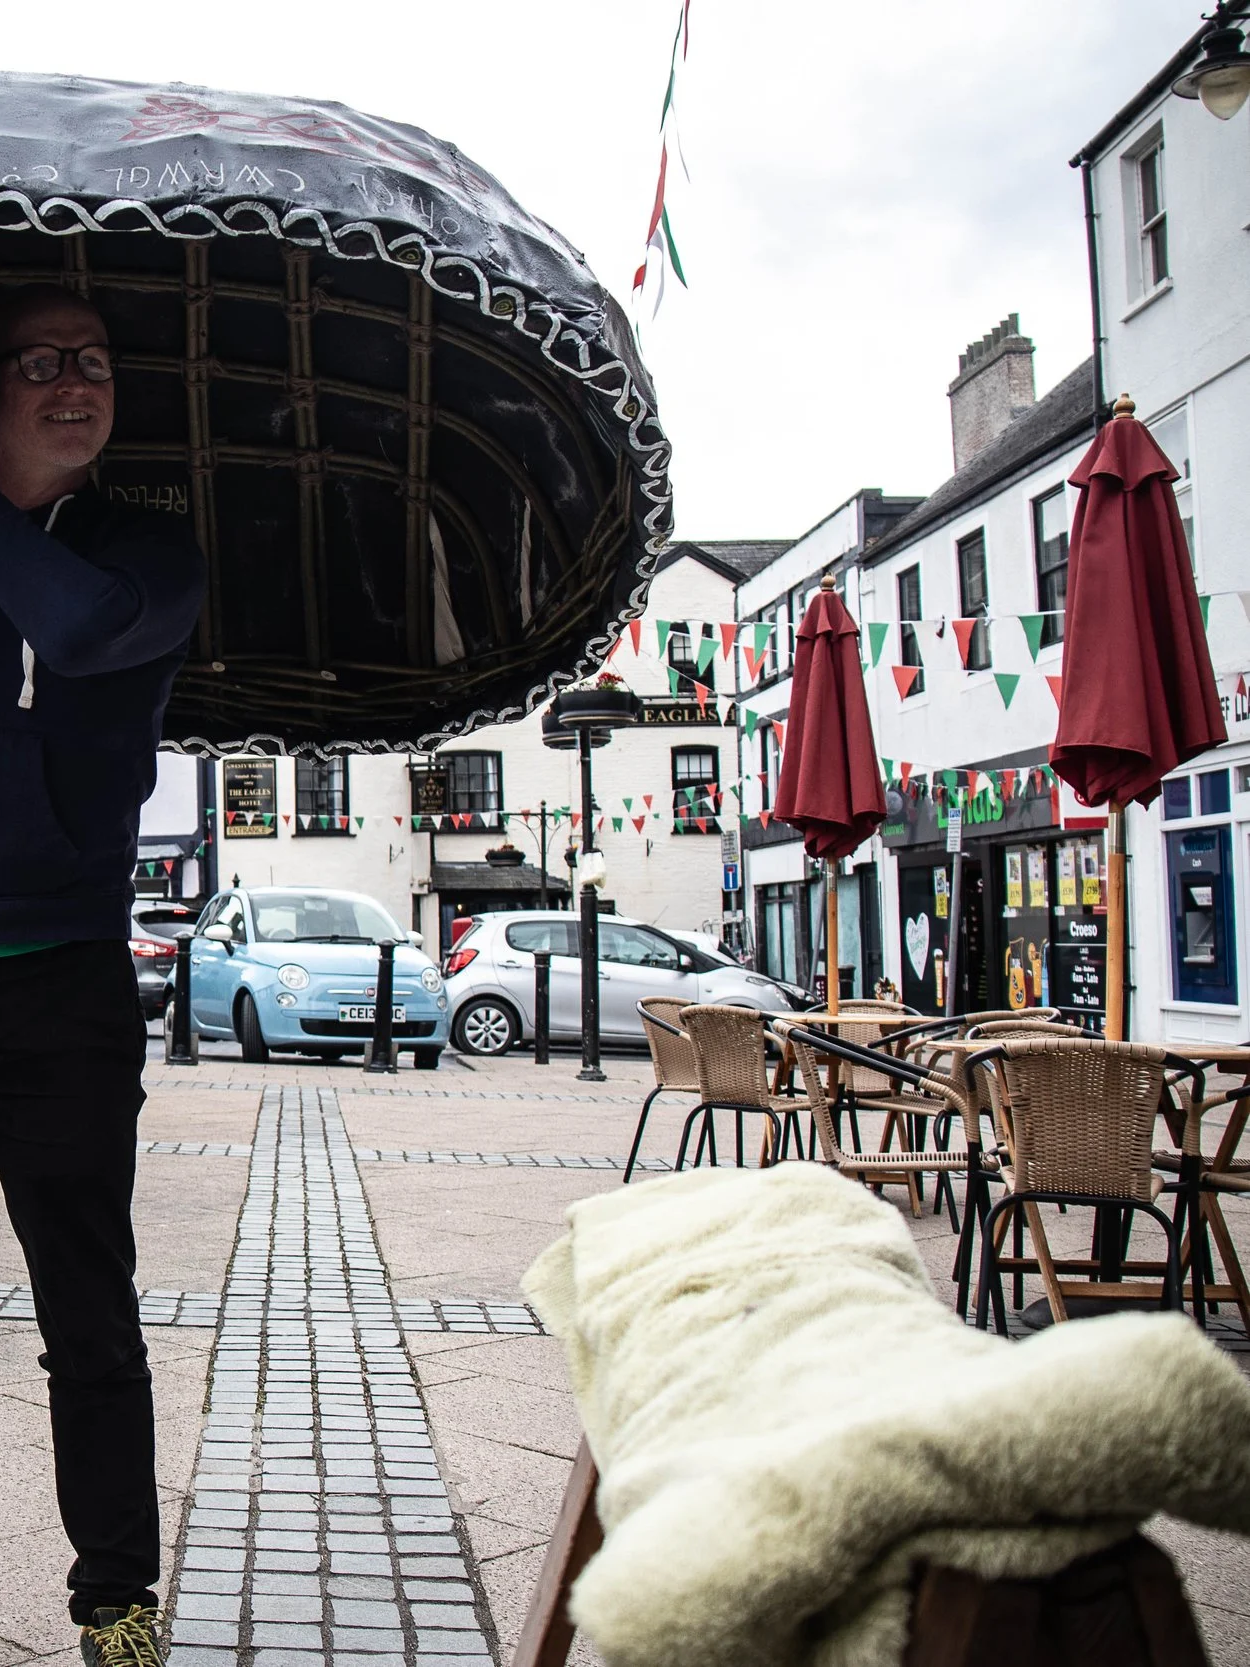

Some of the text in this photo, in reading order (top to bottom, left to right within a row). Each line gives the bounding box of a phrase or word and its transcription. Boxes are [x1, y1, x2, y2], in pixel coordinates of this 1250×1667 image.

[105, 159, 305, 192] CWRWGL
[644, 708, 718, 722] EAGLES
[229, 788, 271, 797] THE EAGLES
[229, 826, 267, 834] ENTRANCE
[1070, 920, 1098, 937] Croeso
